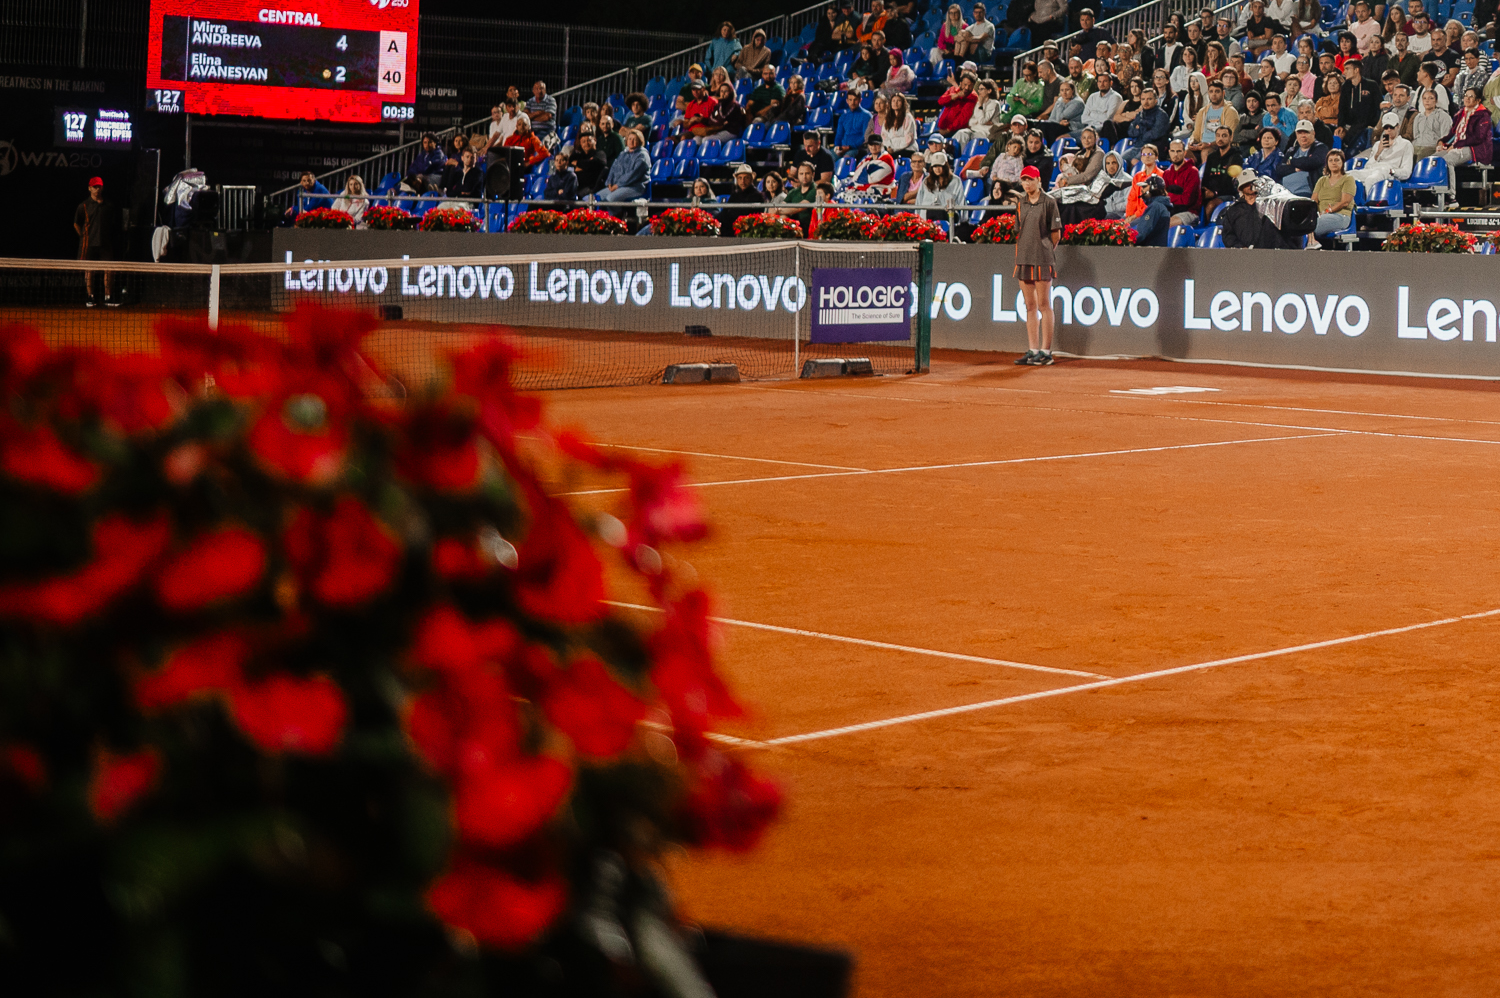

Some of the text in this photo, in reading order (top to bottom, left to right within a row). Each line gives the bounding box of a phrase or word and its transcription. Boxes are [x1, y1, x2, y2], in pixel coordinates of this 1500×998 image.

[258, 8, 321, 26] CENTRAL
[193, 20, 227, 34] Mirra
[192, 32, 262, 48] ANDREEVA
[336, 35, 348, 51] 4
[387, 40, 399, 53] A
[191, 53, 222, 66] Elina
[190, 65, 268, 81] AVANESYAN
[335, 66, 346, 82] 2
[382, 70, 401, 83] 40
[0, 76, 105, 93] REATNESS IN THE MAKING
[437, 88, 457, 97] OPEN
[154, 90, 181, 104] 127
[157, 102, 180, 114] km/h
[383, 105, 415, 119] 00:38
[64, 112, 87, 130] 127
[401, 254, 516, 300] Lenovo
[529, 261, 654, 306] Lenovo
[669, 262, 807, 314] Lenovo
[819, 285, 905, 308] HOLOGIC
[889, 311, 900, 319] Sure
[1184, 278, 1370, 337] Lenovo
